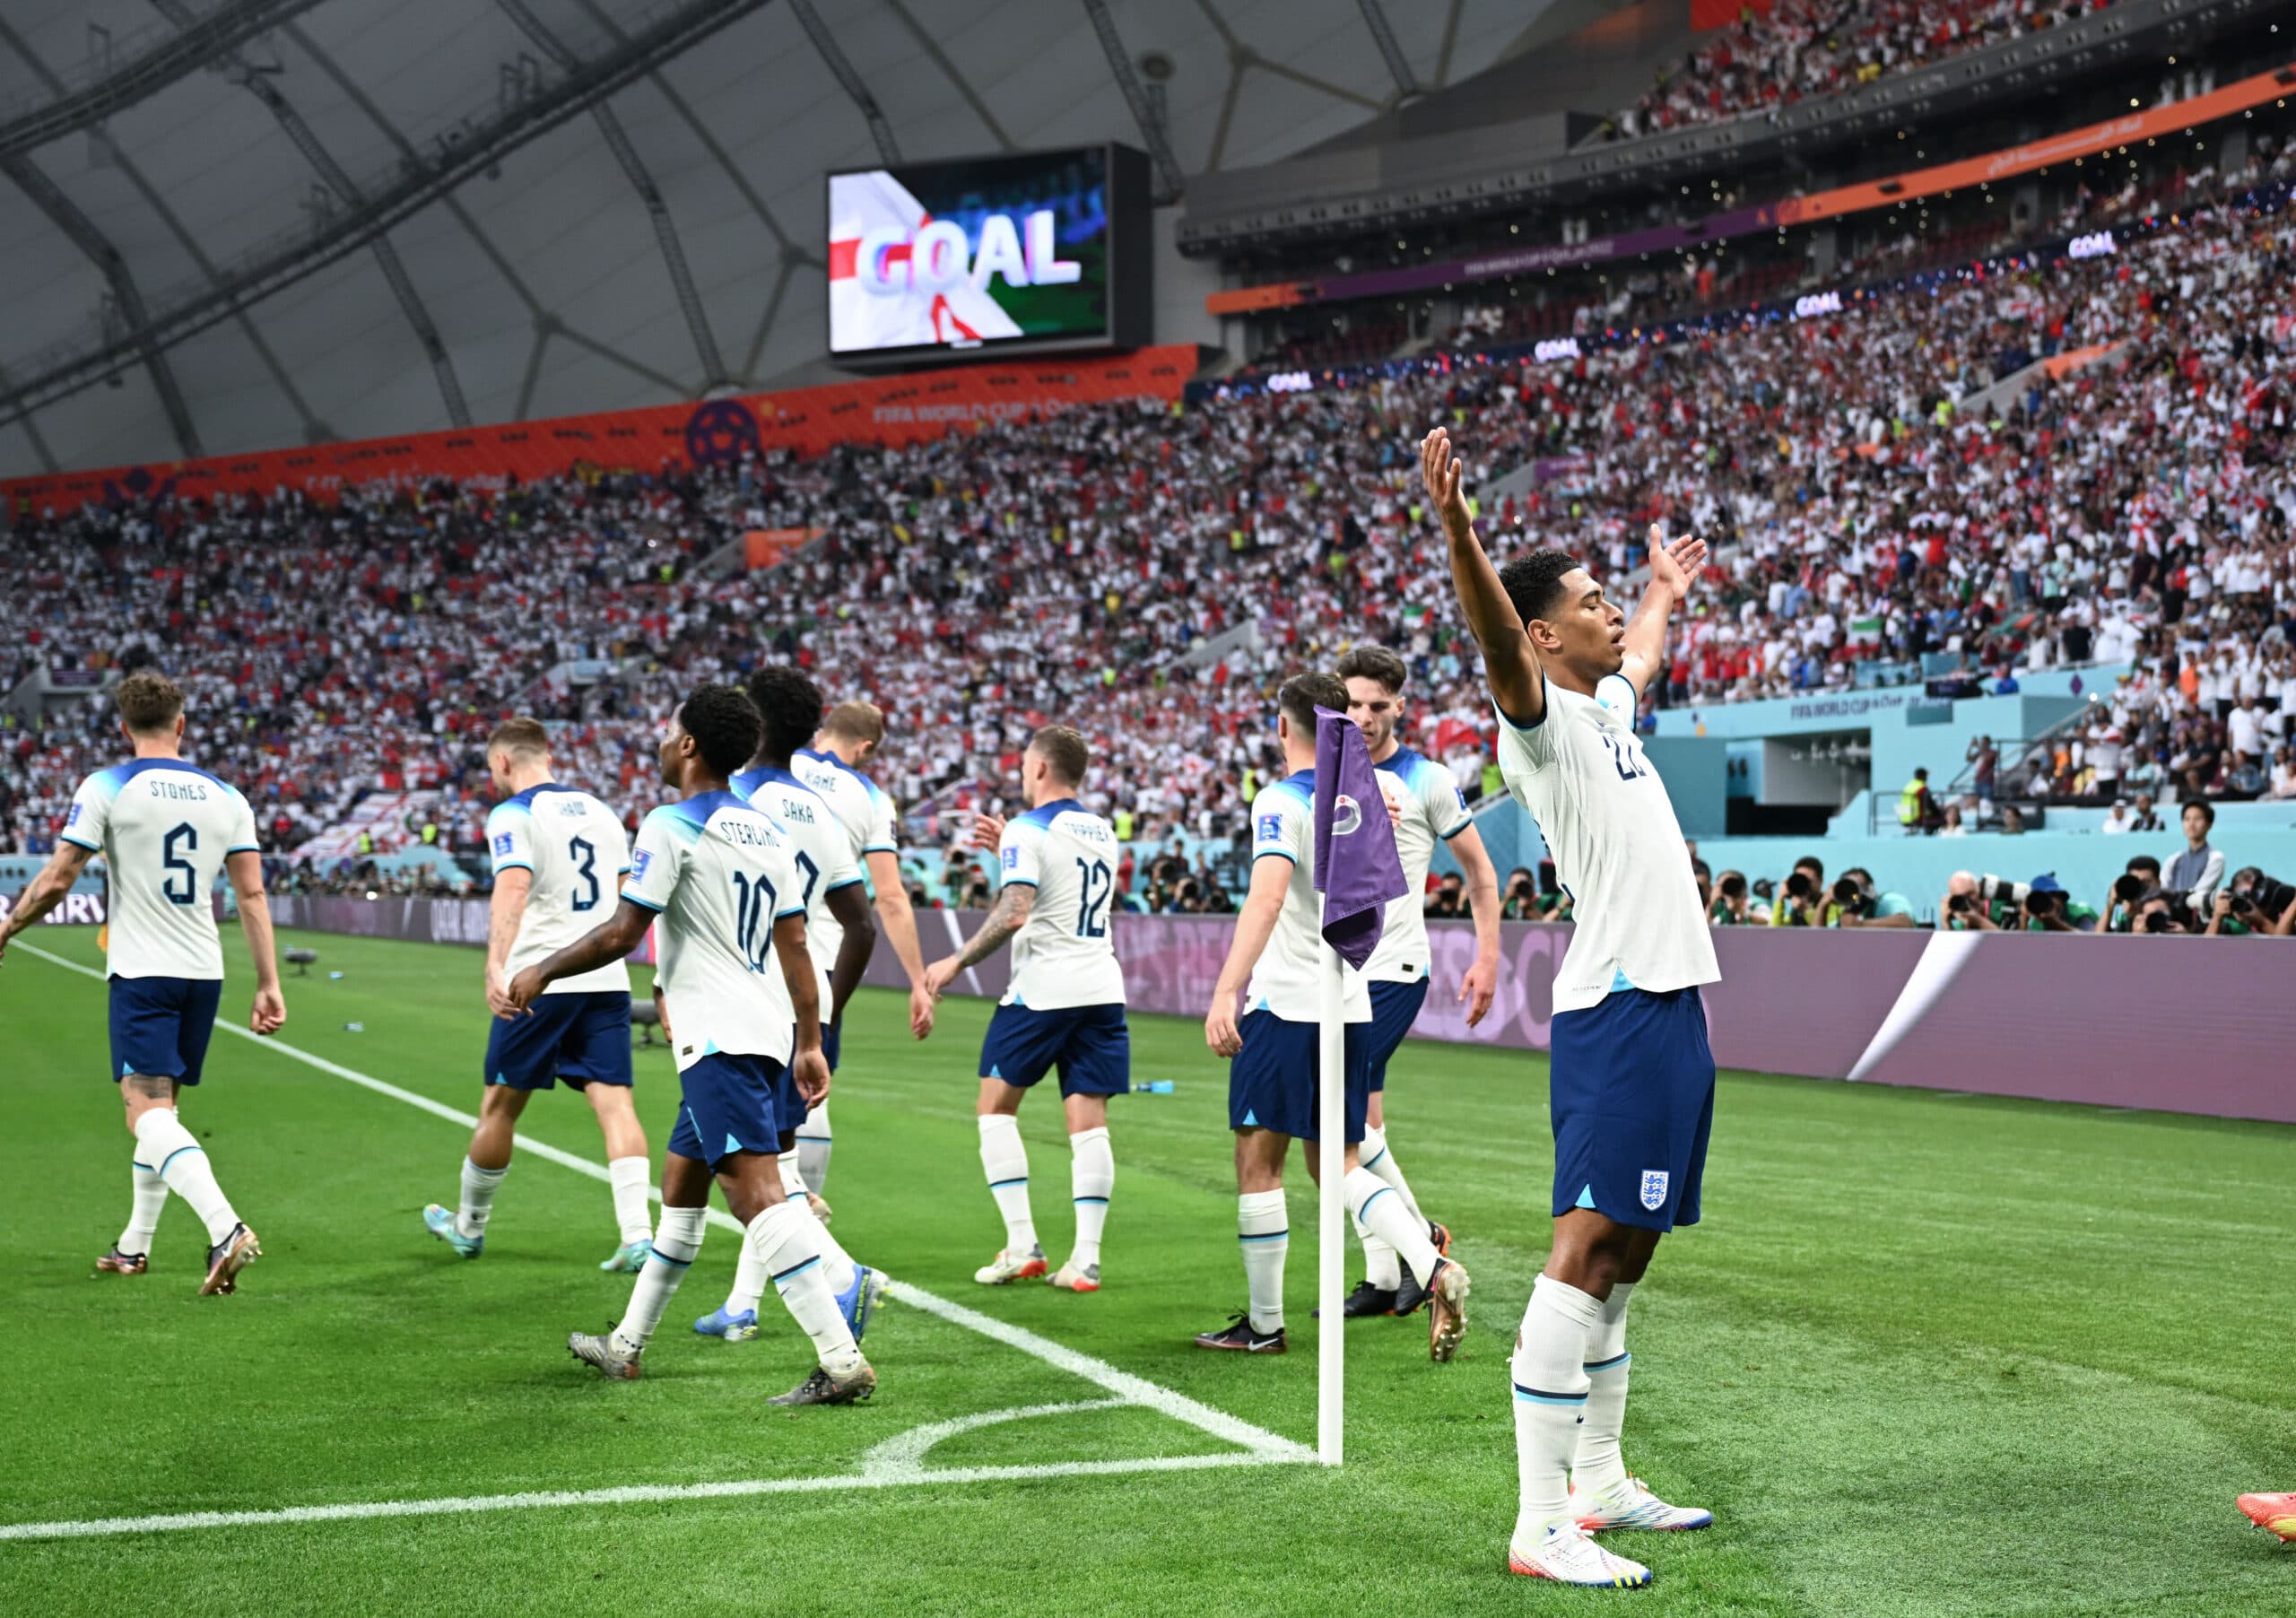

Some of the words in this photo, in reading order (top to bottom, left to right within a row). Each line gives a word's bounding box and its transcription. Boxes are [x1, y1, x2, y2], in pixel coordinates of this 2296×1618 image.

[856, 209, 1082, 297] GOAL
[2068, 231, 2116, 258] GOAL
[1796, 291, 1843, 318] GOAL
[1535, 338, 1581, 361] GOAL
[1267, 371, 1312, 392] GOAL
[918, 404, 986, 422] WORLD
[1813, 700, 1848, 717] WORLD
[1850, 699, 1870, 715] CUP
[151, 780, 207, 800] STONES
[782, 799, 815, 824] SAKA
[163, 822, 197, 905] 5
[569, 835, 600, 912] 3
[1076, 857, 1111, 938] 12
[734, 870, 778, 975] 10
